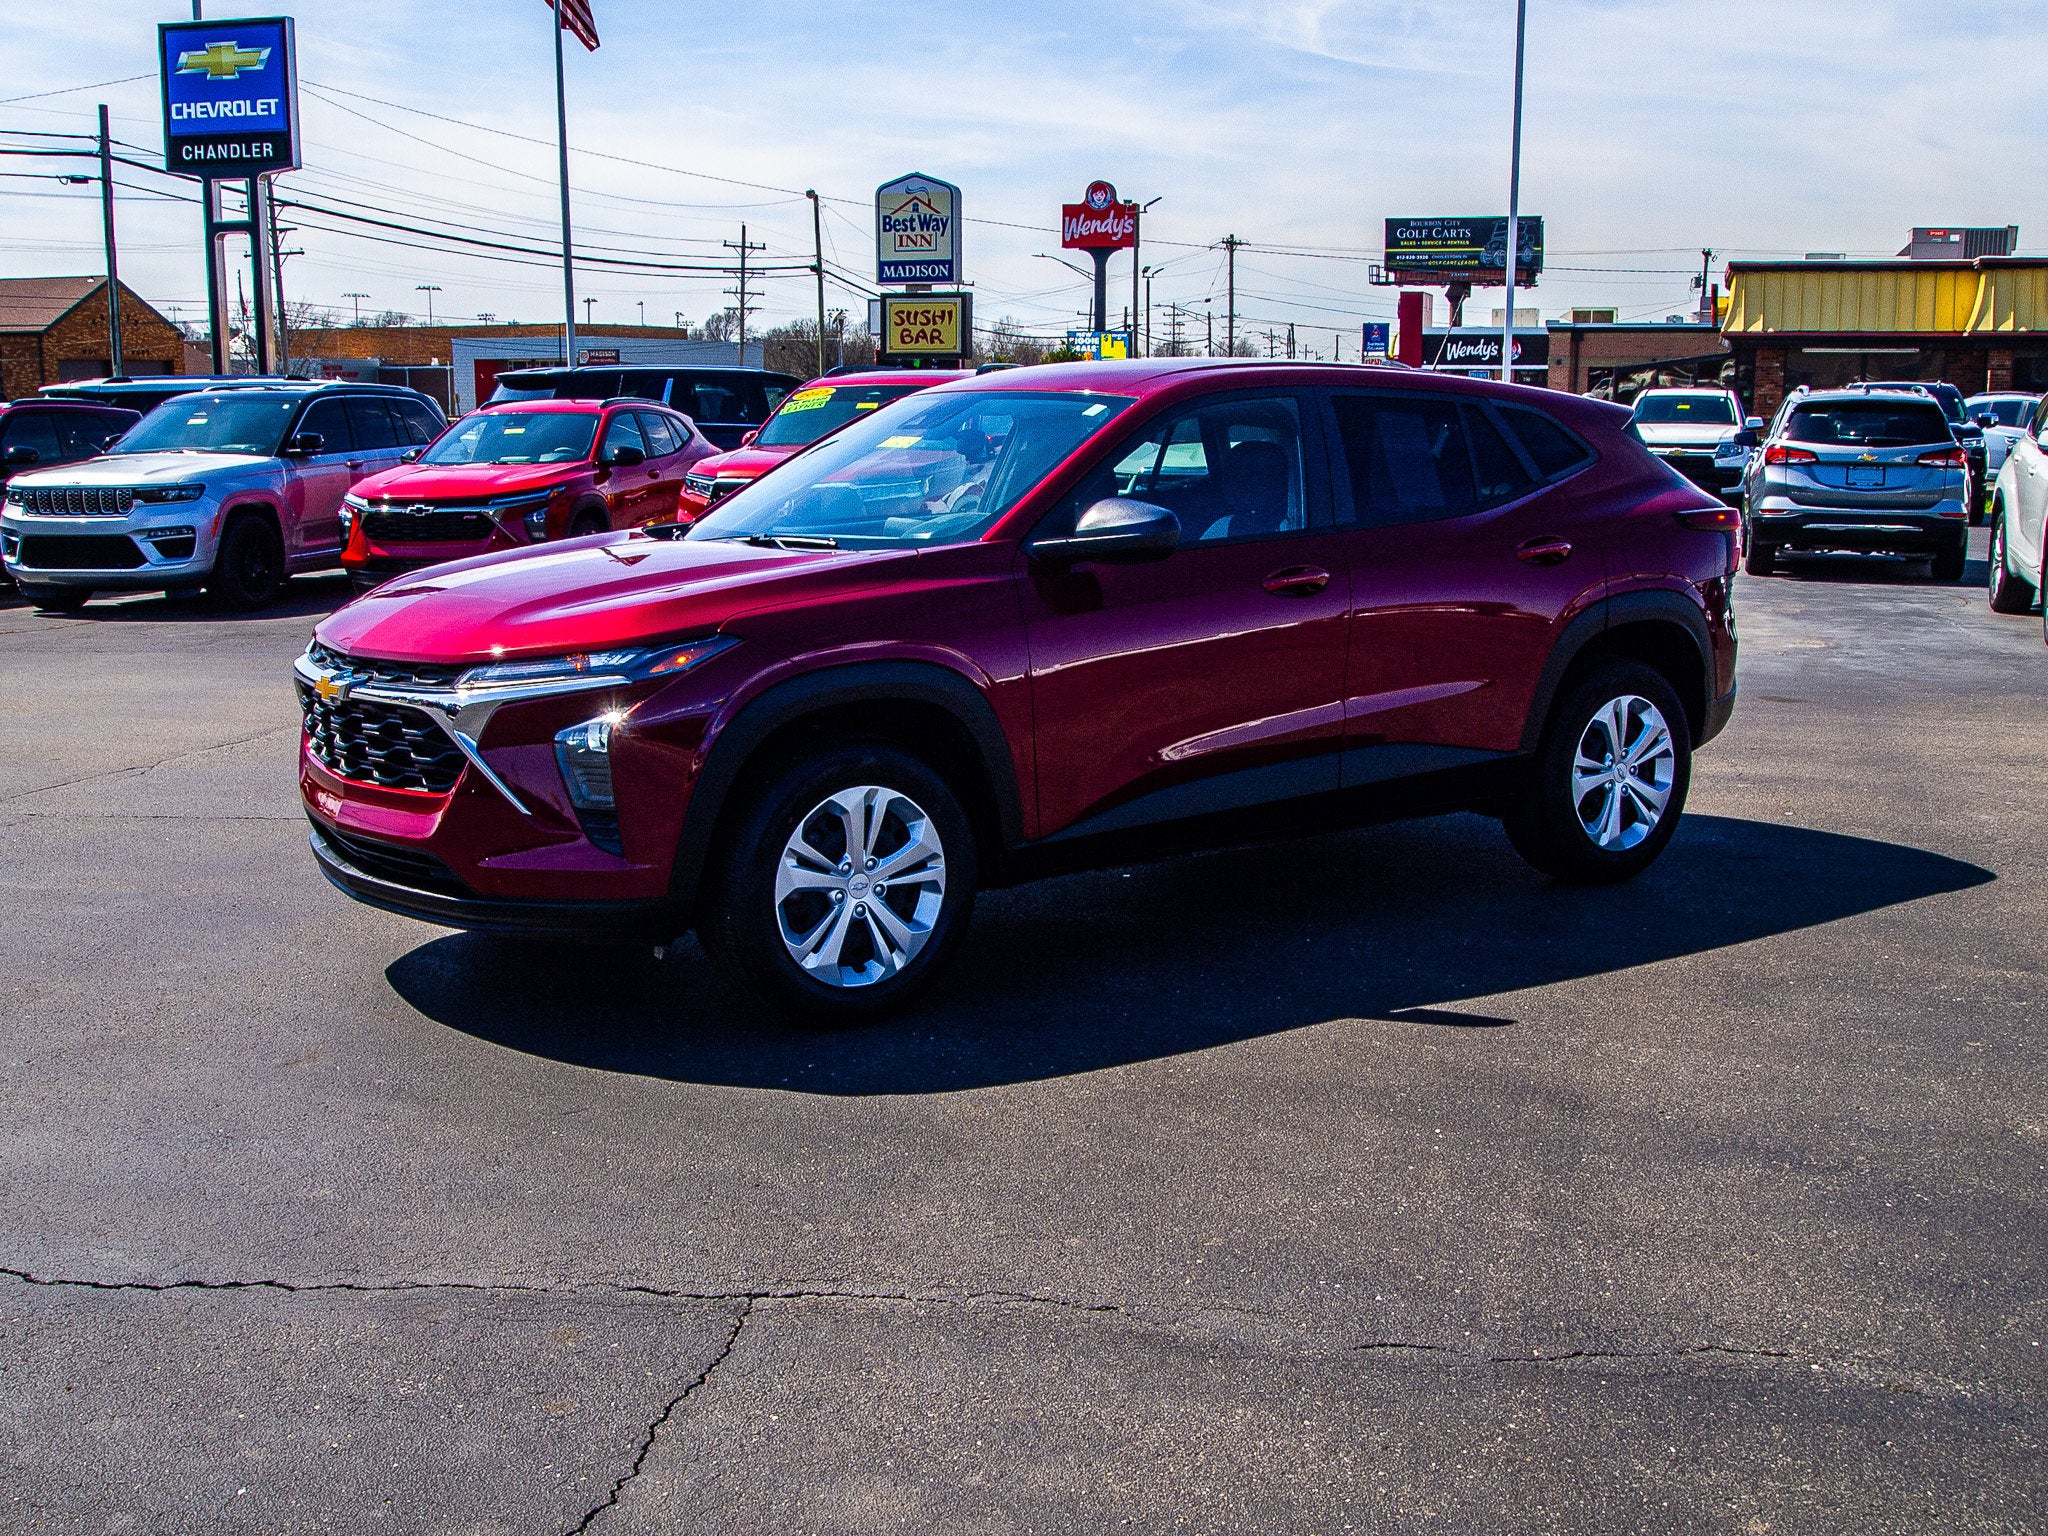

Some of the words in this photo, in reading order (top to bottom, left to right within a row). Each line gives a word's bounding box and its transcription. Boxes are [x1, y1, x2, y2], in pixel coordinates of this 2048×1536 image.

[171, 98, 279, 120] CHEVROLET
[182, 142, 273, 160] CHANDLER
[882, 214, 916, 233] Best
[918, 214, 949, 237] Way
[1064, 210, 1134, 242] Wendy's
[1396, 227, 1428, 239] GOLF
[1432, 227, 1471, 239] CARTS
[897, 233, 934, 248] INN
[882, 264, 949, 278] MADISON
[893, 309, 954, 327] SUSHI
[899, 328, 945, 345] BAR
[1446, 338, 1499, 361] Wendy's
